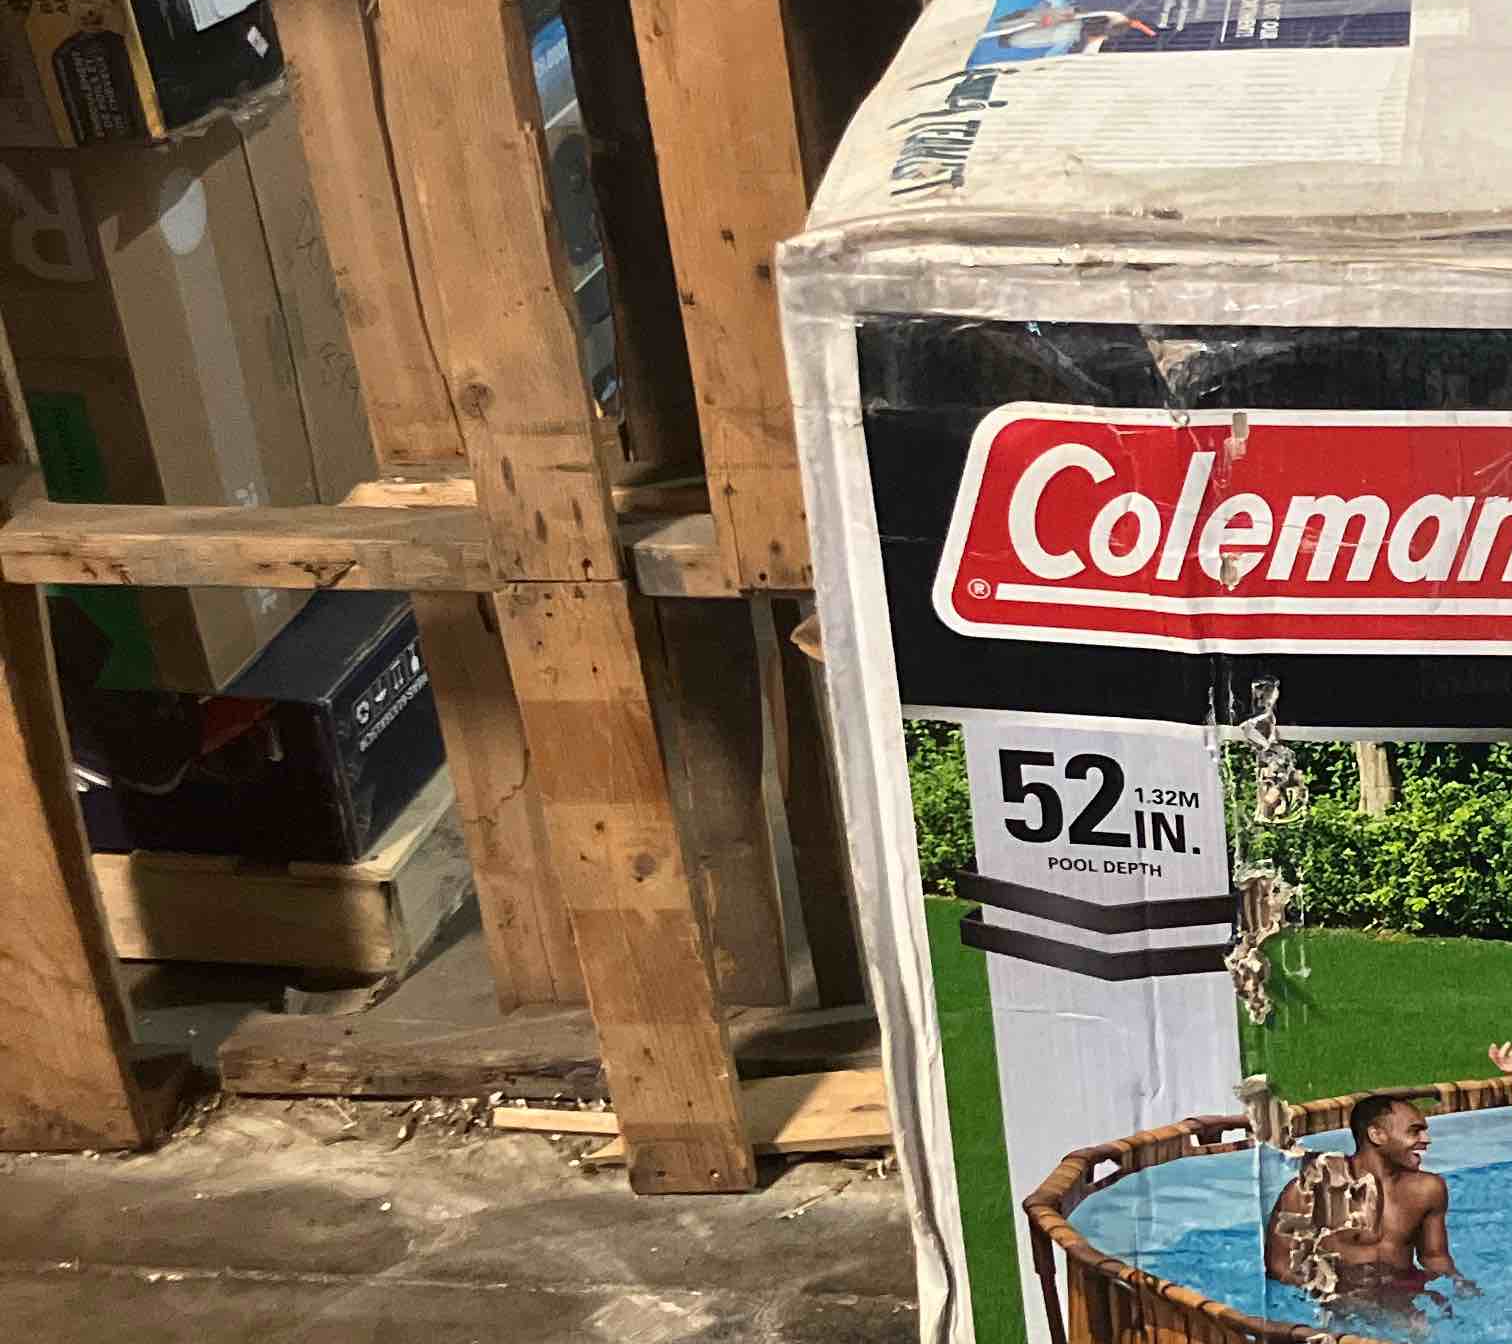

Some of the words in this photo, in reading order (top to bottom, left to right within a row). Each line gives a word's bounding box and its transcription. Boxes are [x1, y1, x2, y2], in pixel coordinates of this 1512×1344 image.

[998, 747, 1132, 849] 52
[1134, 809, 1201, 856] IN.
[1134, 786, 1200, 810] 1.32M
[1047, 856, 1099, 874] POOL
[1103, 859, 1163, 878] DEPTH
